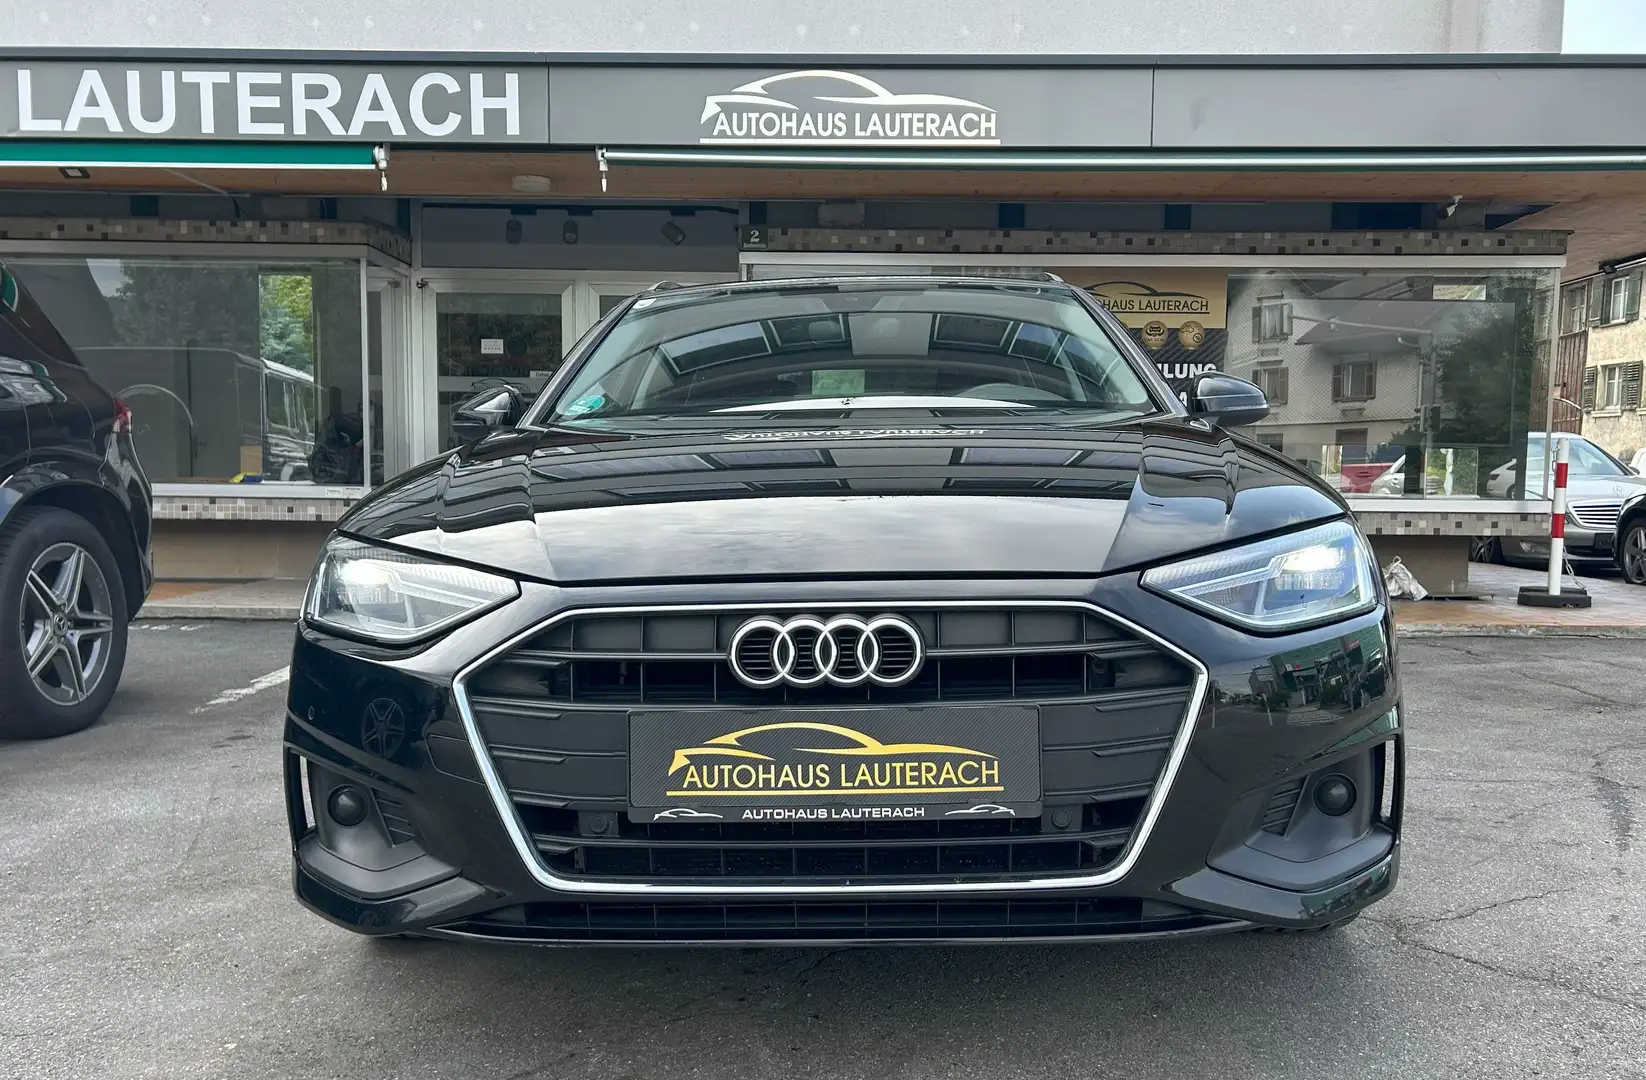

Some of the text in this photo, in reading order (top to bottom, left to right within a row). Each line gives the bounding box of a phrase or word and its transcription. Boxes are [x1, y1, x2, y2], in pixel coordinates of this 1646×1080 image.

[17, 68, 520, 136] LAUTERACH
[712, 111, 997, 137] AUTOHAUS LAUTERACH
[750, 229, 760, 243] 2
[1138, 299, 1210, 312] LAUTERACH
[683, 760, 1000, 790] AUTOHAUS LAUTERACH
[742, 807, 925, 820] AUTOHAUS LAUTERACH
